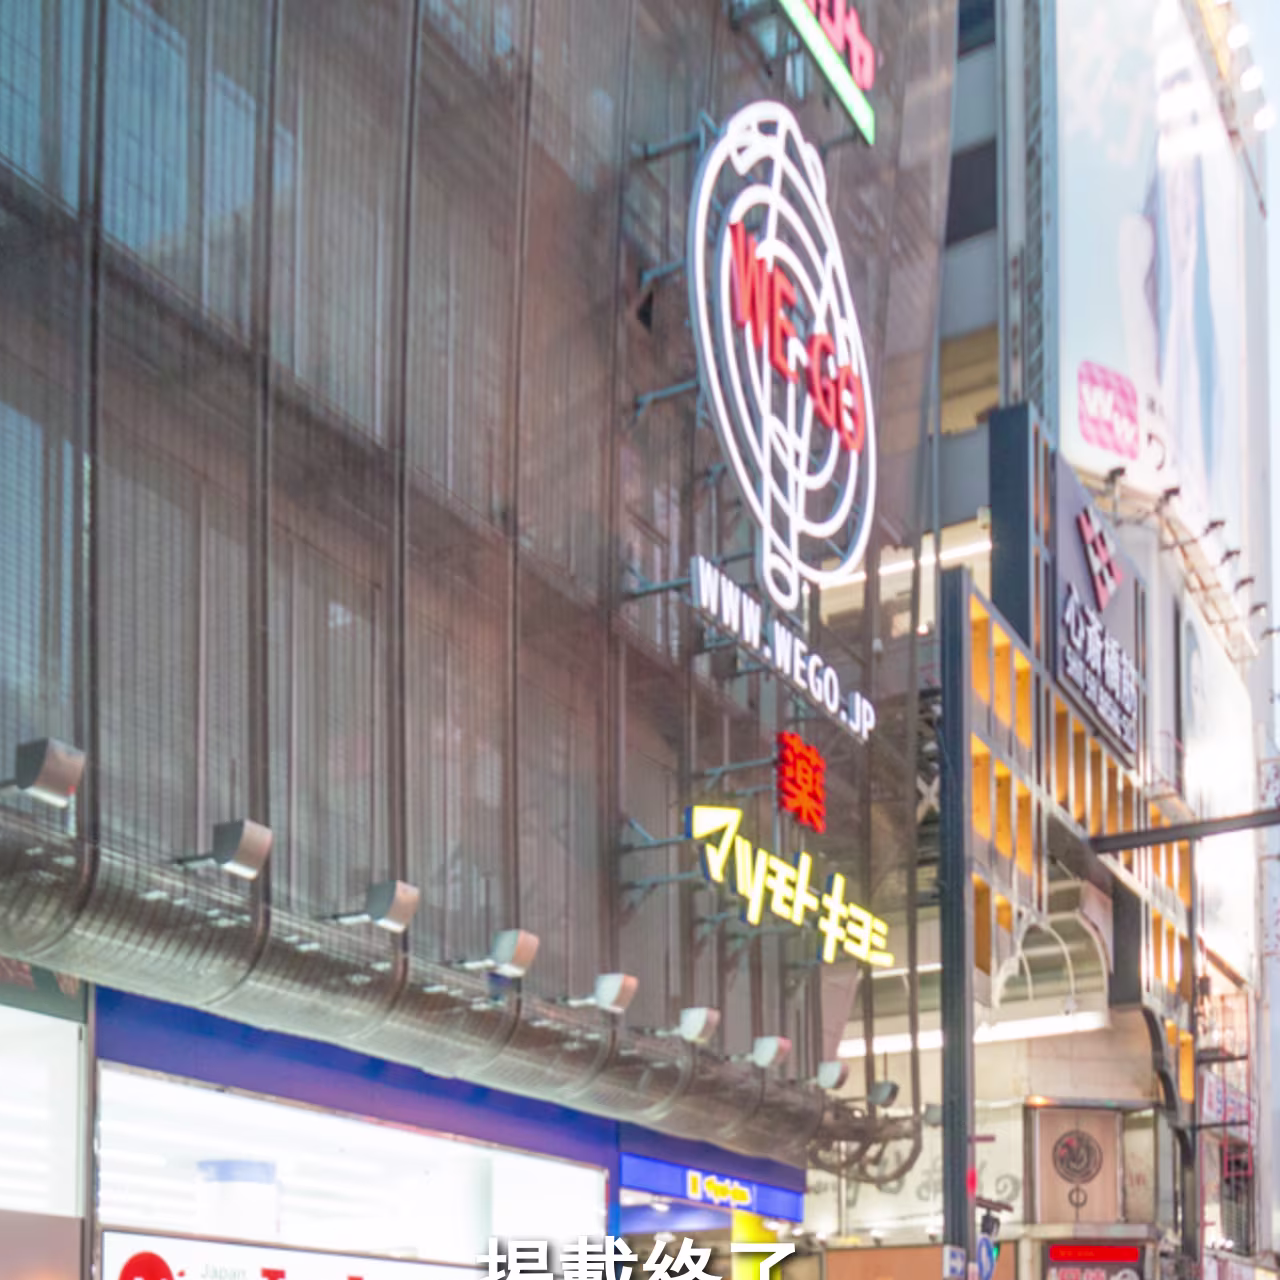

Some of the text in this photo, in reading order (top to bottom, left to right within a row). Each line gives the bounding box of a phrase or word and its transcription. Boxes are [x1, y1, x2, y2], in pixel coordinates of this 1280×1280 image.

[695, 555, 877, 741] WWW.WEGO.JP
[777, 731, 827, 834] 薬
[689, 804, 896, 968] マツモトキヨシ
